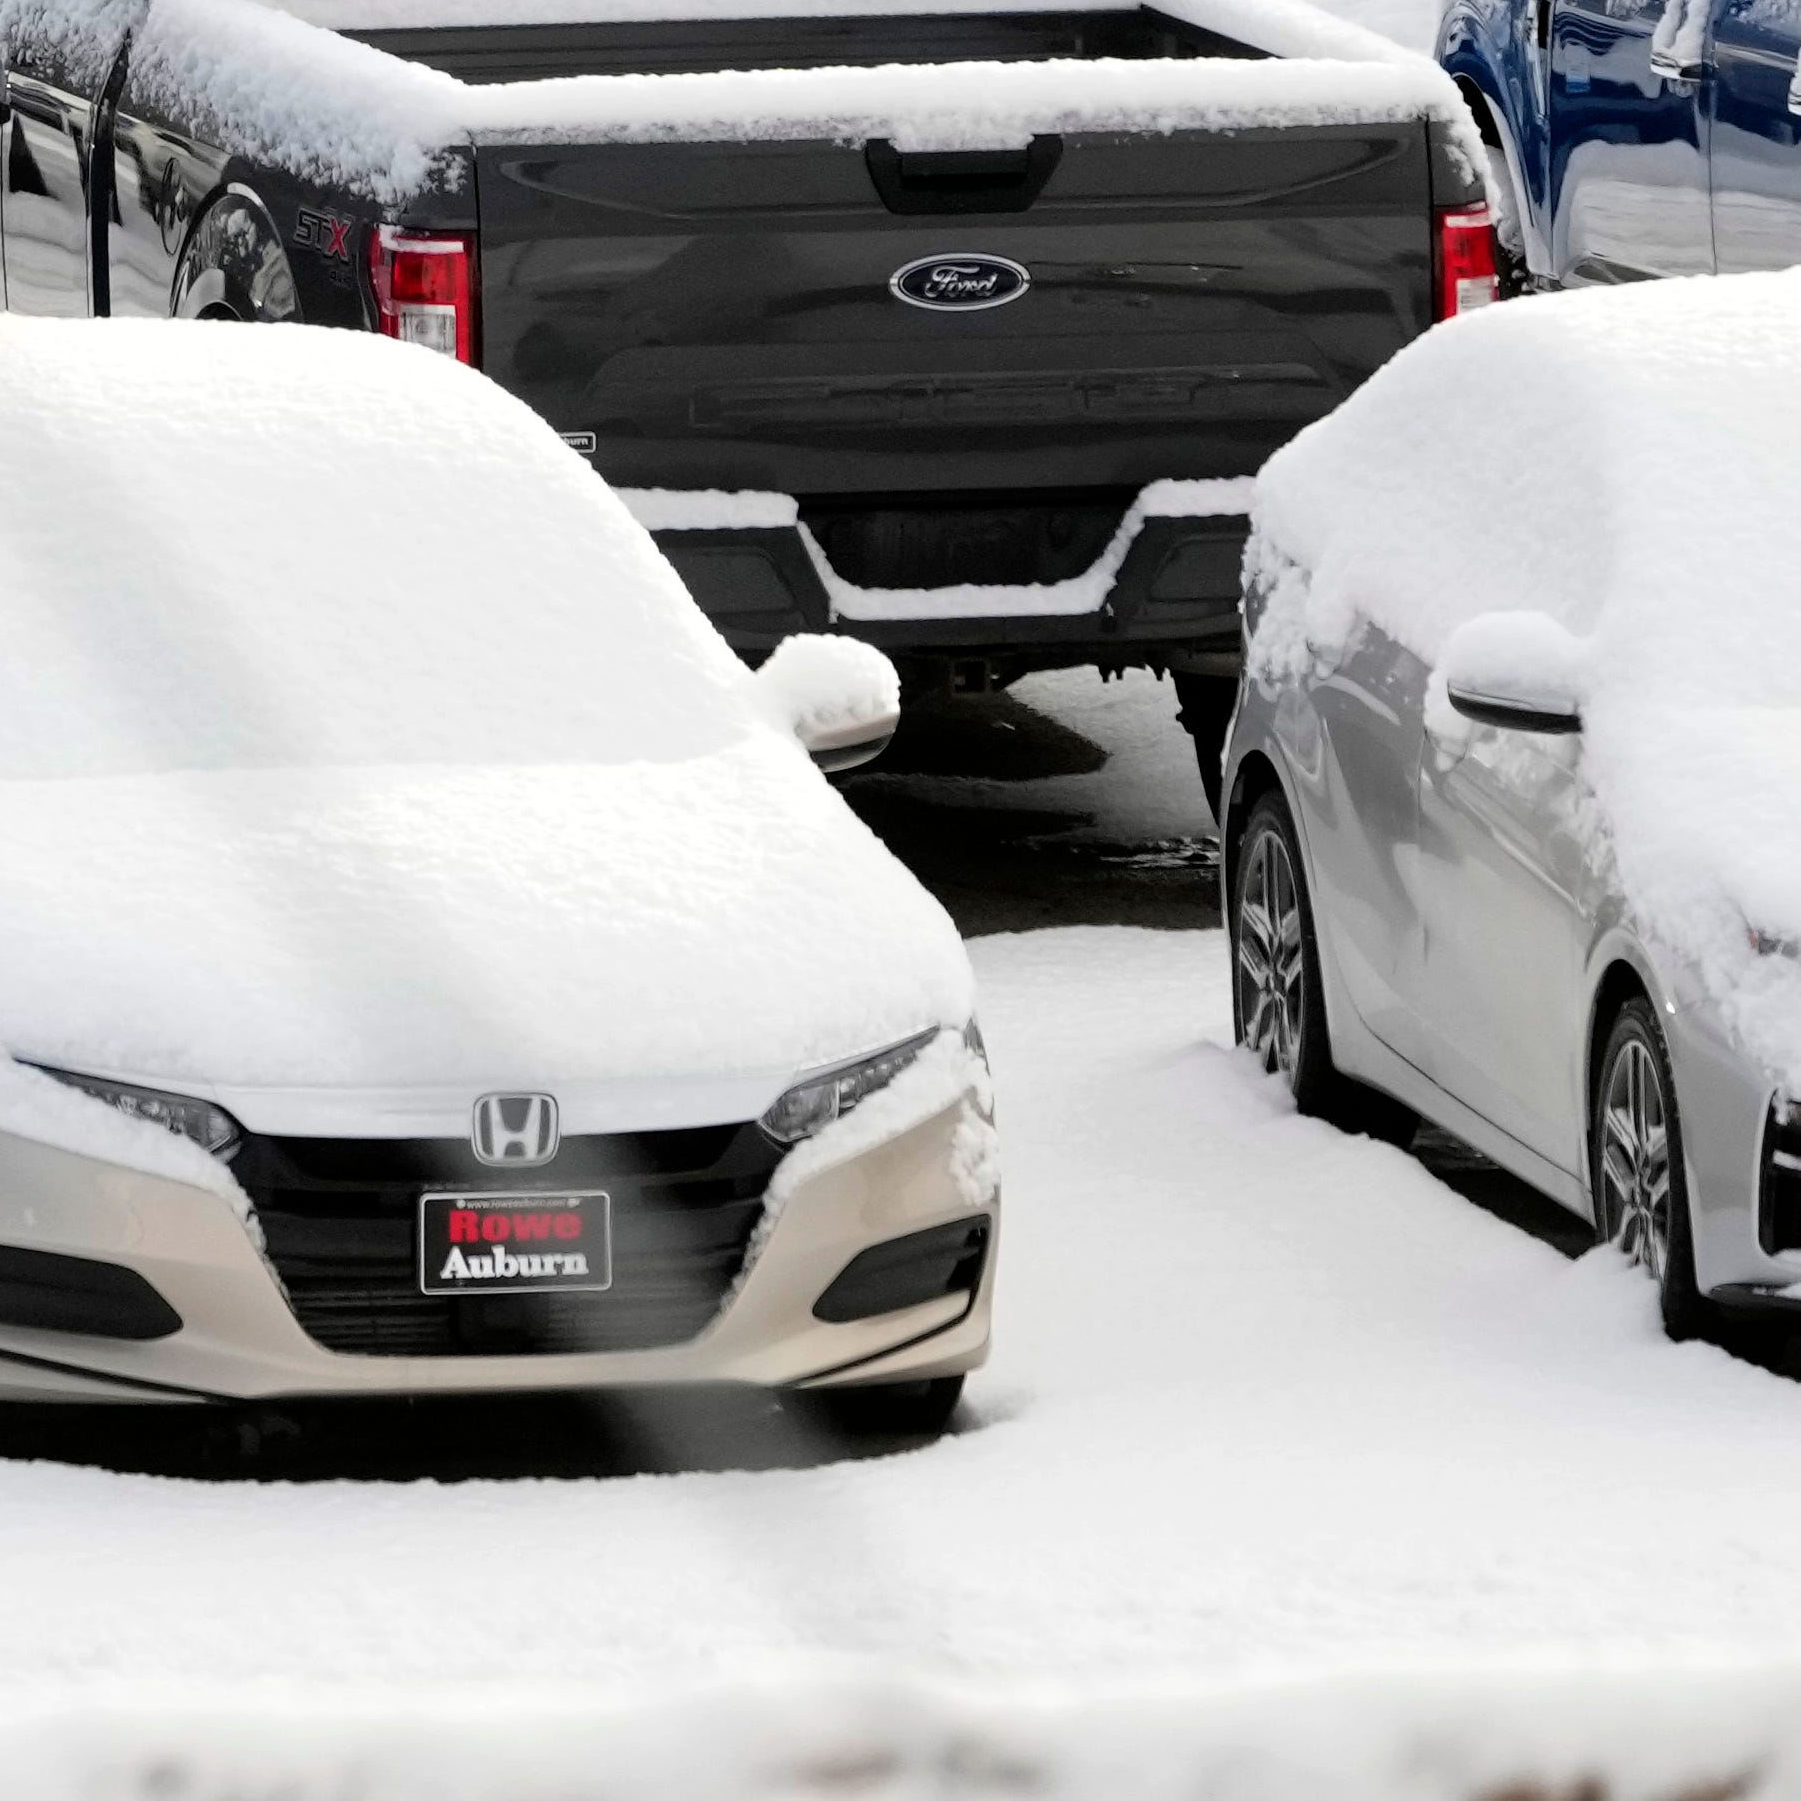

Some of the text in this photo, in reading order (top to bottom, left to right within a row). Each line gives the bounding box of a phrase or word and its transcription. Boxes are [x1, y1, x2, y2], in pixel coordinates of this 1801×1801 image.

[925, 264, 998, 299] Ford
[449, 1208, 582, 1243] Rowe
[440, 1243, 590, 1280] Auburn
